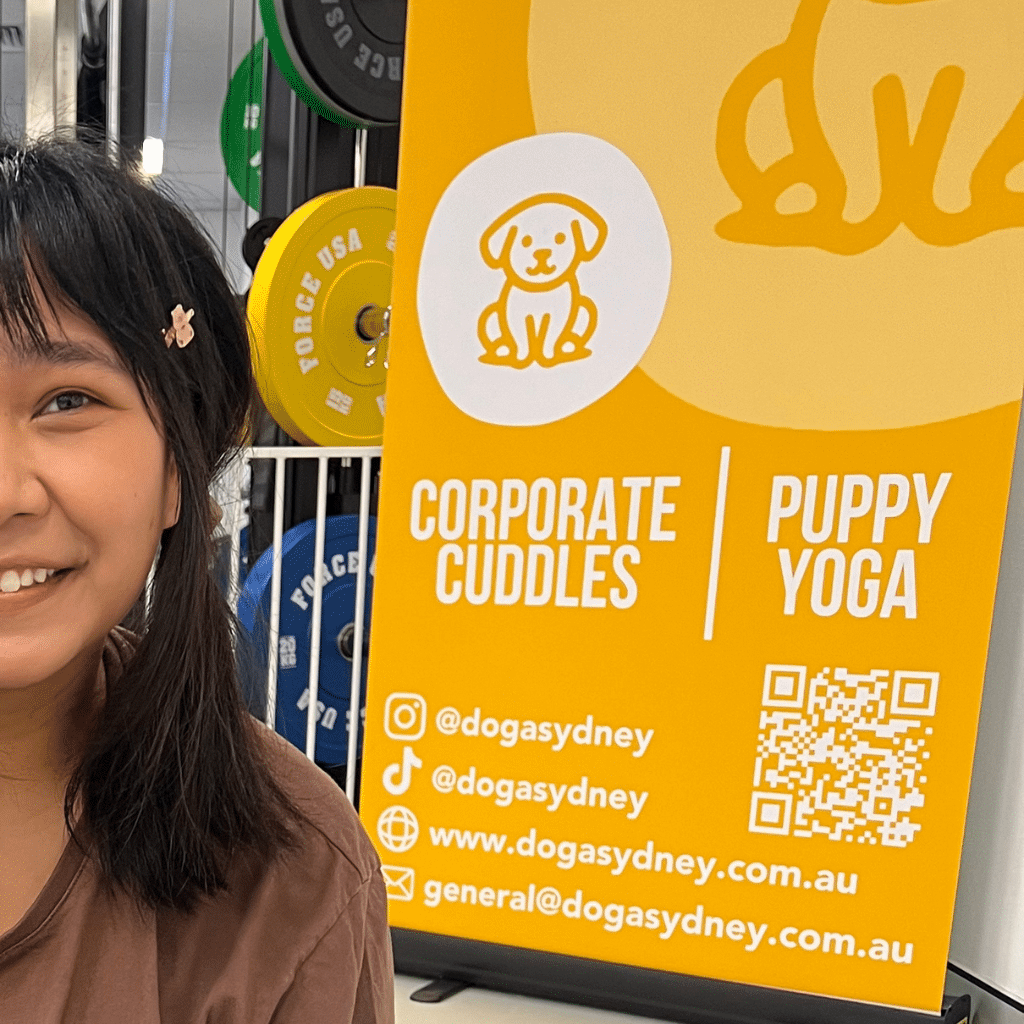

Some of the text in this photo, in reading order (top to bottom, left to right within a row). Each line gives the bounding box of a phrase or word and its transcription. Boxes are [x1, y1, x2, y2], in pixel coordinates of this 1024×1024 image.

[353, 43, 402, 81] RCE
[293, 227, 363, 375] FORCE USA
[410, 475, 681, 541] CORPORATE
[766, 472, 953, 544] PUPPY
[435, 543, 641, 609] CUDDLES
[777, 548, 918, 619] YOGA
[435, 706, 655, 758] @dogasydney
[431, 764, 649, 820] @dogasydney
[429, 826, 858, 895] www.dogasydney.com.au
[423, 884, 914, 964] general@dogasydney.com.au
